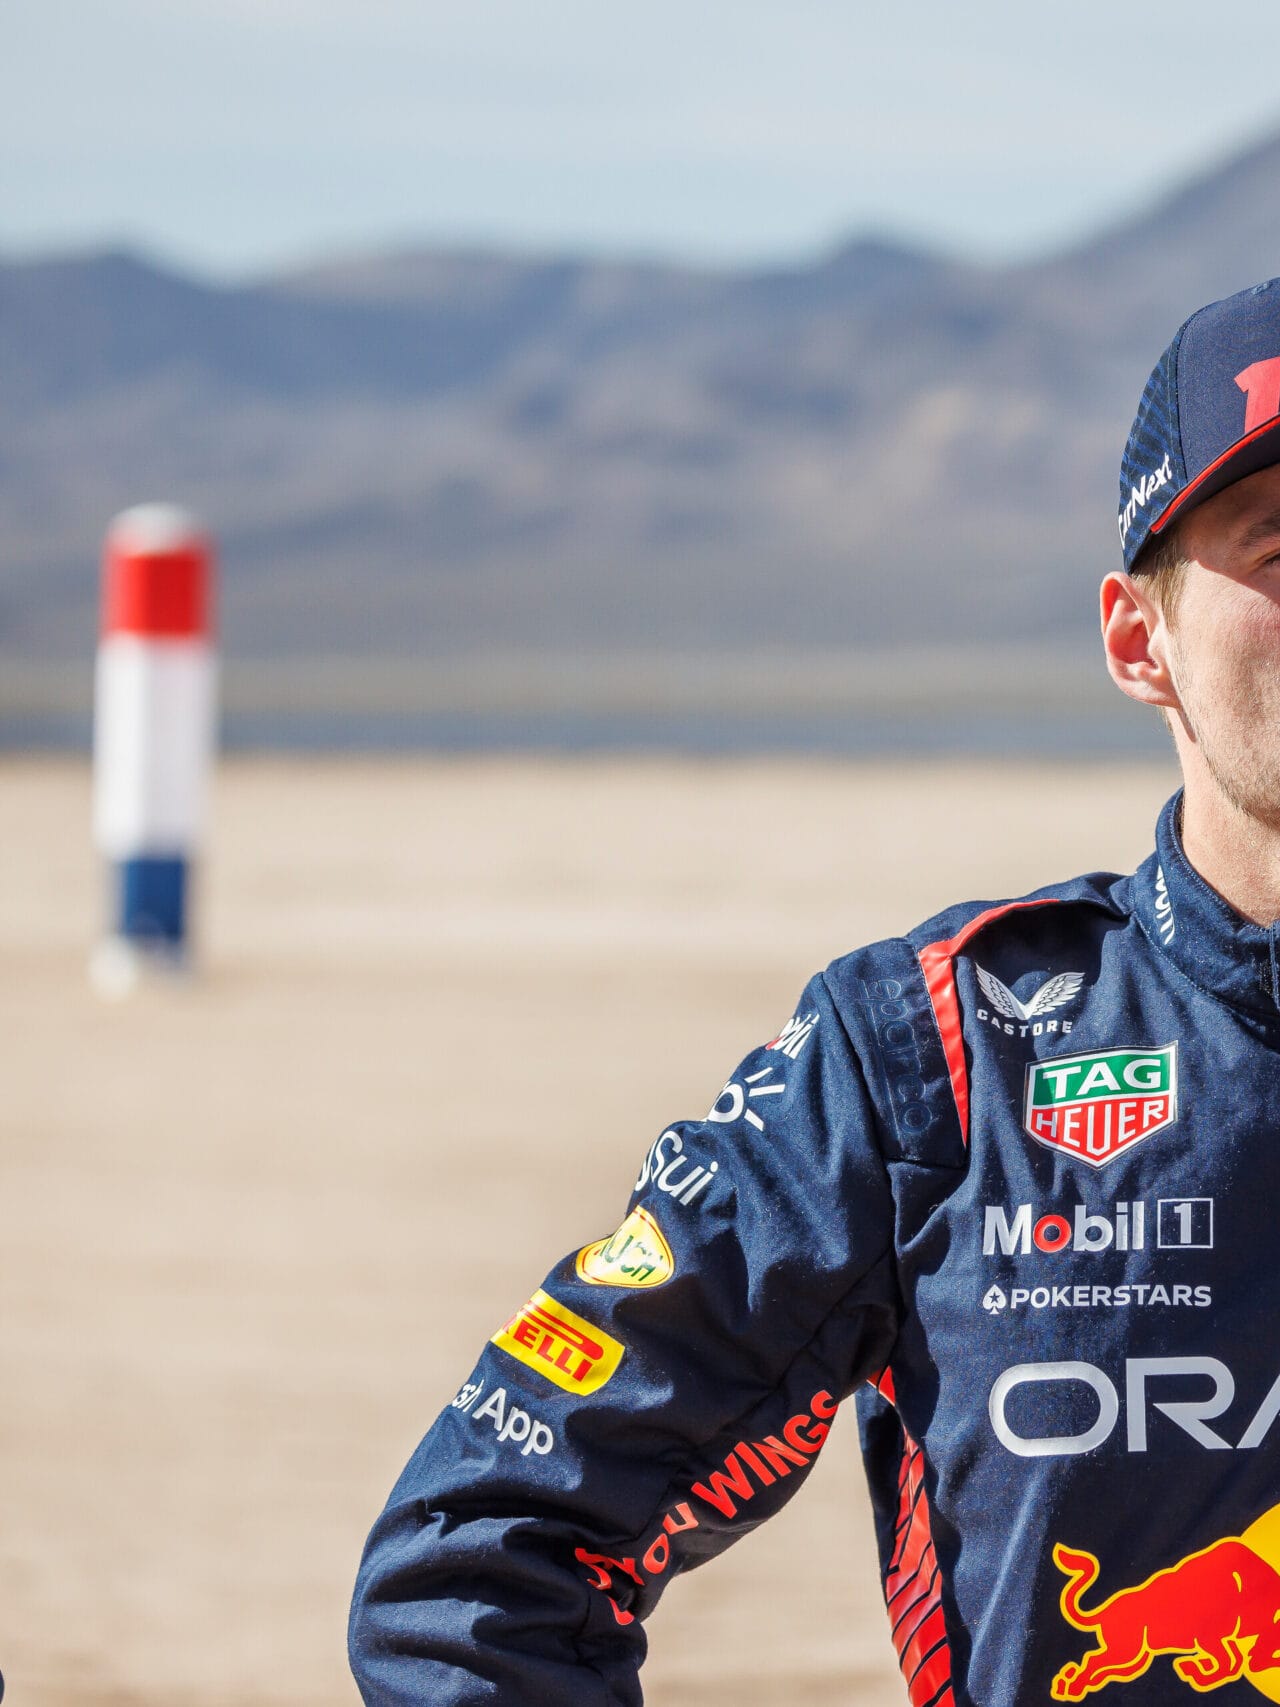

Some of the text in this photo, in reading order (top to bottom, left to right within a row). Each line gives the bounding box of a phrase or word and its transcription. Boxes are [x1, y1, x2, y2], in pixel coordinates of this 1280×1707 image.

[977, 1008, 1073, 1038] CASTORE
[1042, 1058, 1162, 1099] TAG
[1036, 1099, 1165, 1158] HEUER
[982, 1201, 1145, 1255] Mobil
[1011, 1284, 1212, 1309] POKERSTARS
[472, 1387, 554, 1456] App
[691, 1390, 839, 1519] WINGS
